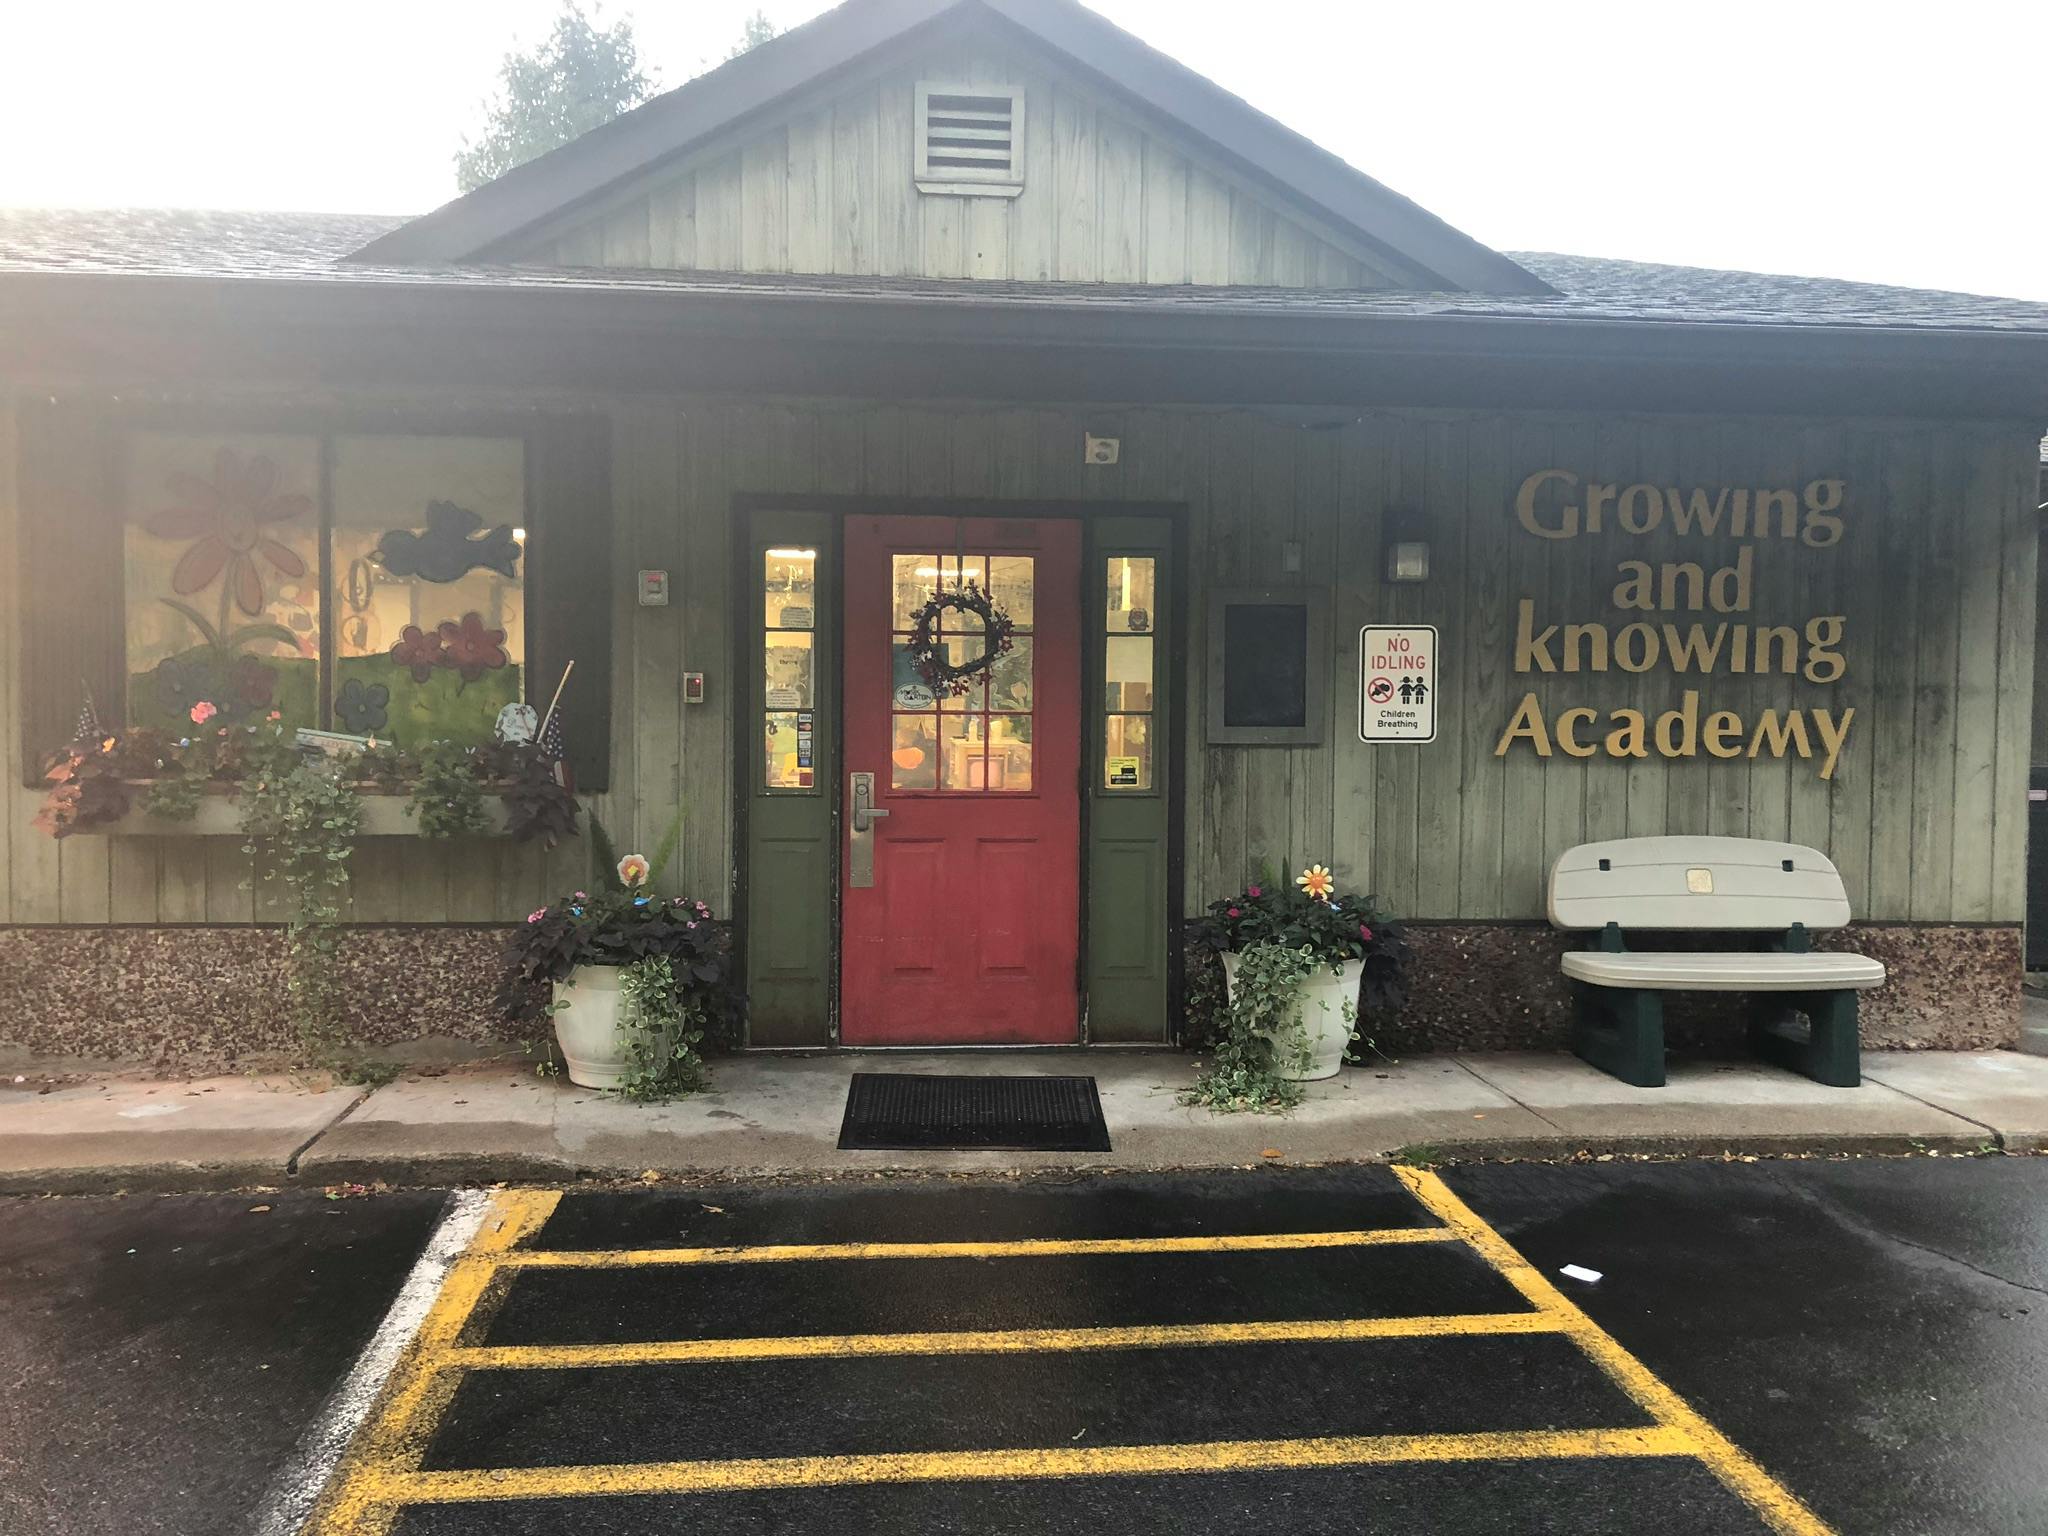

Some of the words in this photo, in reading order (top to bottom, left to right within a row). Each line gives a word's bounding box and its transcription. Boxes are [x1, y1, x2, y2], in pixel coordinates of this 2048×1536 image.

[1515, 469, 1846, 547] Growing
[1612, 545, 1753, 613] and
[1387, 638, 1410, 652] NO
[1514, 598, 1847, 683] knowing
[1371, 655, 1426, 670] IDLING
[1380, 710, 1415, 718] Children
[1378, 720, 1418, 729] Breathing
